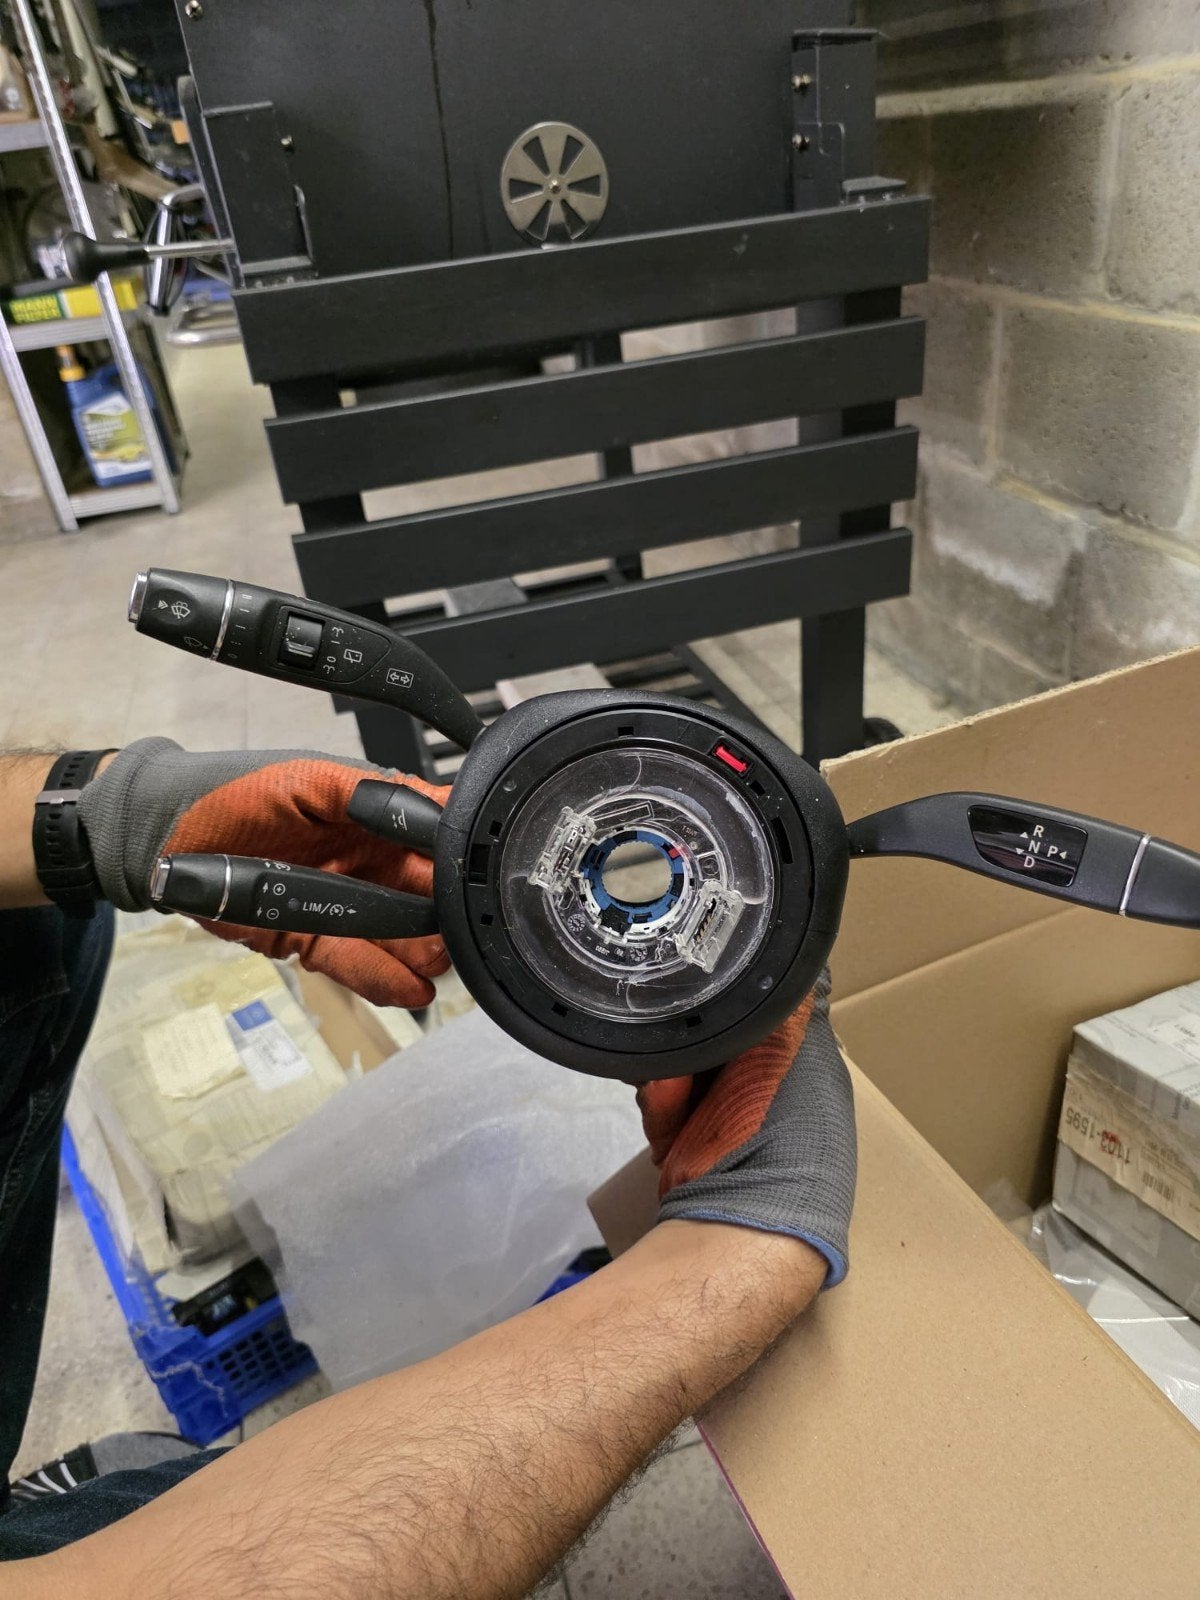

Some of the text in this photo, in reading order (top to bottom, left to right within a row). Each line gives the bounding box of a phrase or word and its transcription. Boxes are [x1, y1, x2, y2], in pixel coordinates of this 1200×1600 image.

[1033, 825, 1044, 838] R
[1029, 840, 1041, 854] N
[1047, 845, 1059, 857] P
[1024, 856, 1035, 868] D
